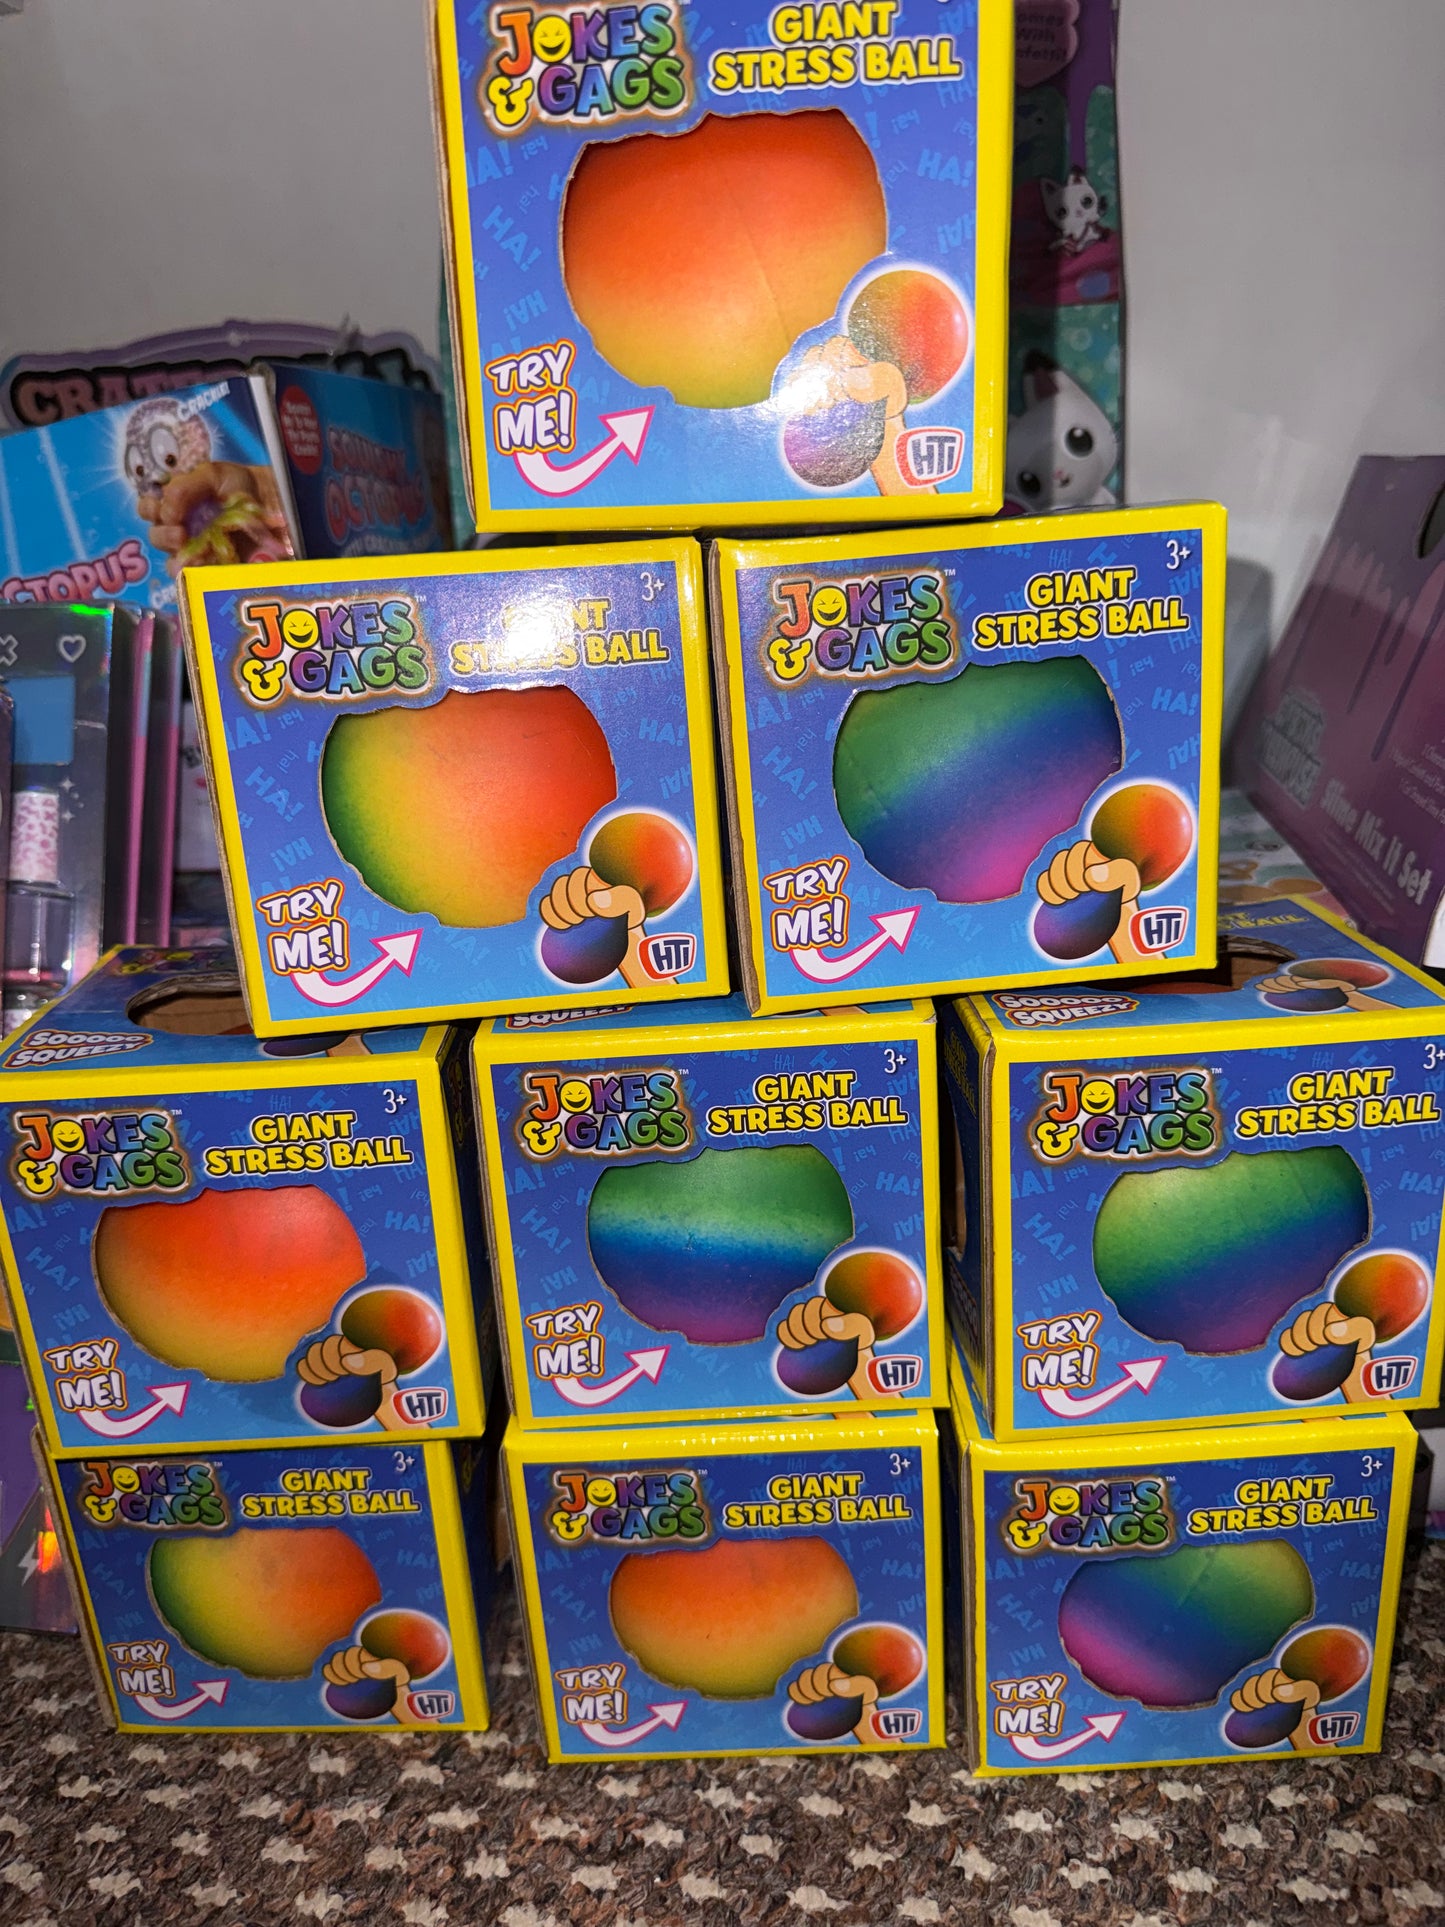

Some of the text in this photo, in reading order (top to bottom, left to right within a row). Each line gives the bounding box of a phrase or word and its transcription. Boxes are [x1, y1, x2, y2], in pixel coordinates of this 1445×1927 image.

[496, 2, 676, 76] JOKES
[775, 0, 898, 45] GIANT
[714, 38, 960, 91] STRESS BALL
[488, 56, 684, 127] & GAGS
[489, 347, 571, 390] TRY
[497, 393, 571, 448] ME!
[1166, 539, 1193, 569] 3+
[639, 571, 667, 600] 3+
[1029, 569, 1135, 607] GIANT
[778, 575, 942, 638] JOKES
[977, 599, 1187, 647] STRESS BALL
[245, 600, 417, 660] JOKES
[585, 632, 667, 664] BALL
[769, 620, 950, 680] & GAGS
[242, 645, 428, 701] & GAGS
[768, 860, 844, 899] TRY
[261, 883, 339, 921] TRY
[775, 898, 844, 946] ME!
[272, 921, 345, 969] ME!
[1013, 1002, 1131, 1025] SQUEEZY
[10, 1042, 144, 1066] SQUEEZY
[883, 1048, 909, 1073] 3+
[1423, 1043, 1445, 1069] 3+
[382, 1088, 409, 1113] 3+
[529, 1073, 678, 1121] JOKES
[757, 1073, 854, 1102] GIANT
[1047, 1072, 1206, 1124] JOKES
[1291, 1070, 1393, 1101] GIANT
[253, 1114, 354, 1143] GIANT
[522, 1110, 687, 1154] & GAGS
[710, 1099, 905, 1133] STRESS BALL
[1239, 1095, 1439, 1135] STRESS BALL
[18, 1112, 174, 1161] JOKES
[1037, 1111, 1213, 1158] & GAGS
[18, 1151, 185, 1194] & GAGS
[208, 1138, 411, 1175] STRESS BALL
[530, 1305, 598, 1335] TRY
[1022, 1313, 1096, 1345] TRY
[47, 1341, 115, 1369] TRY
[537, 1336, 600, 1374] ME!
[1026, 1346, 1094, 1386] ME!
[59, 1372, 124, 1407] ME!
[393, 1451, 417, 1471] 3+
[889, 1453, 913, 1475] 3+
[1360, 1455, 1385, 1476] 3+
[83, 1463, 215, 1499] JOKES
[283, 1471, 369, 1491] GIANT
[560, 1474, 696, 1514] JOKES
[770, 1475, 863, 1499] GIANT
[1239, 1478, 1332, 1504] GIANT
[84, 1495, 225, 1525] & GAGS
[244, 1492, 419, 1515] STRESS BALL
[727, 1497, 910, 1526] STRESS BALL
[1019, 1480, 1161, 1523] JOKES
[1190, 1499, 1376, 1532] STRESS BALL
[553, 1505, 704, 1540] & GAGS
[1009, 1512, 1168, 1549] & GAGS
[108, 1642, 166, 1662] TRY
[118, 1666, 174, 1693] ME!
[559, 1665, 620, 1688] TRY
[995, 1675, 1061, 1701] TRY
[567, 1691, 622, 1720] ME!
[1000, 1702, 1060, 1734] ME!
